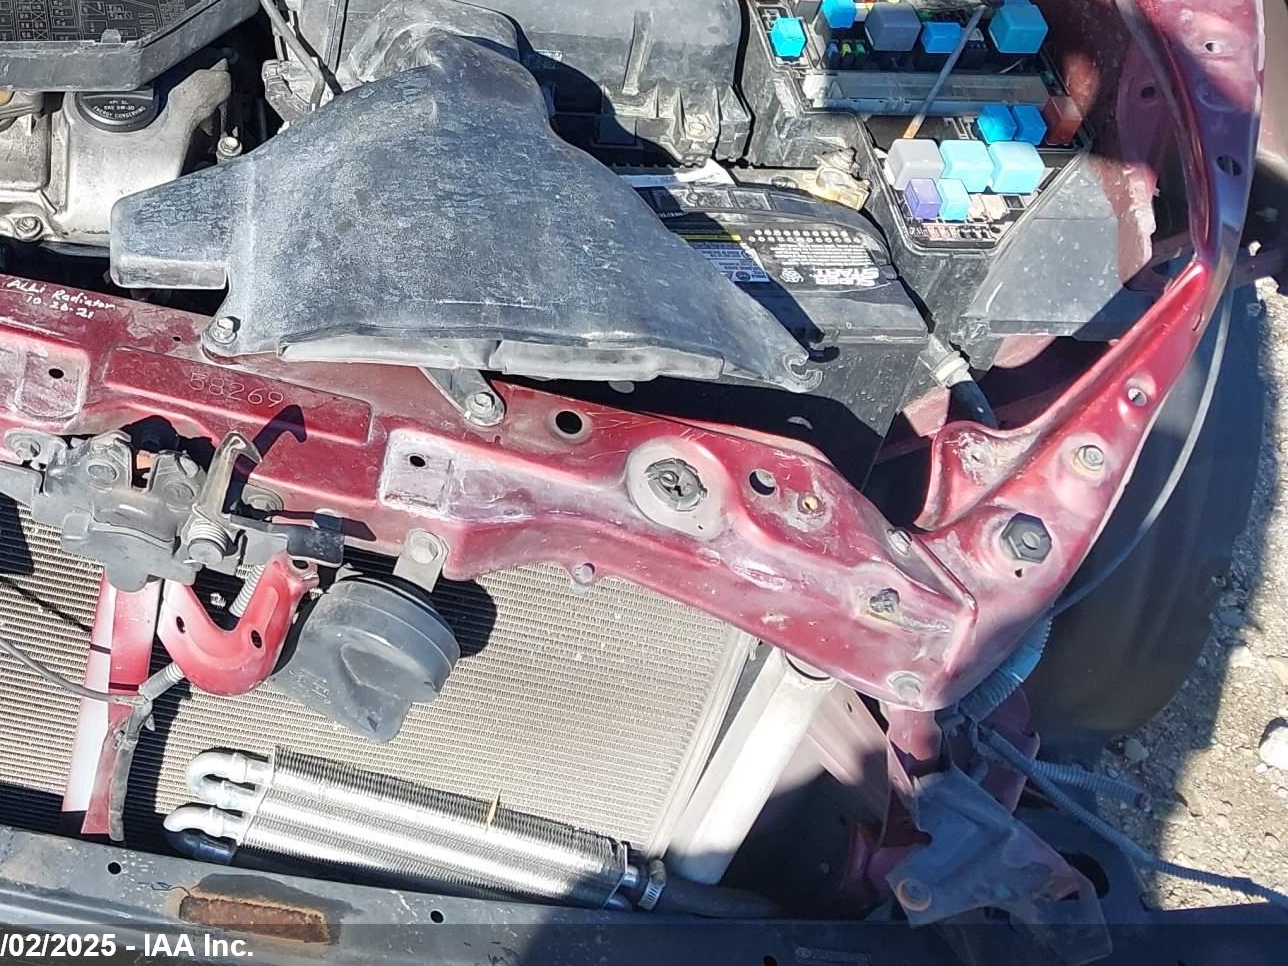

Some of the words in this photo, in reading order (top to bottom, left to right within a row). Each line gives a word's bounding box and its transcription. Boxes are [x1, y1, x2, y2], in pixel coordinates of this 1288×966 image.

[92, 105, 113, 117] ENERGY
[812, 267, 880, 278] START
[815, 277, 876, 286] SUPER
[188, 372, 284, 408] 58269
